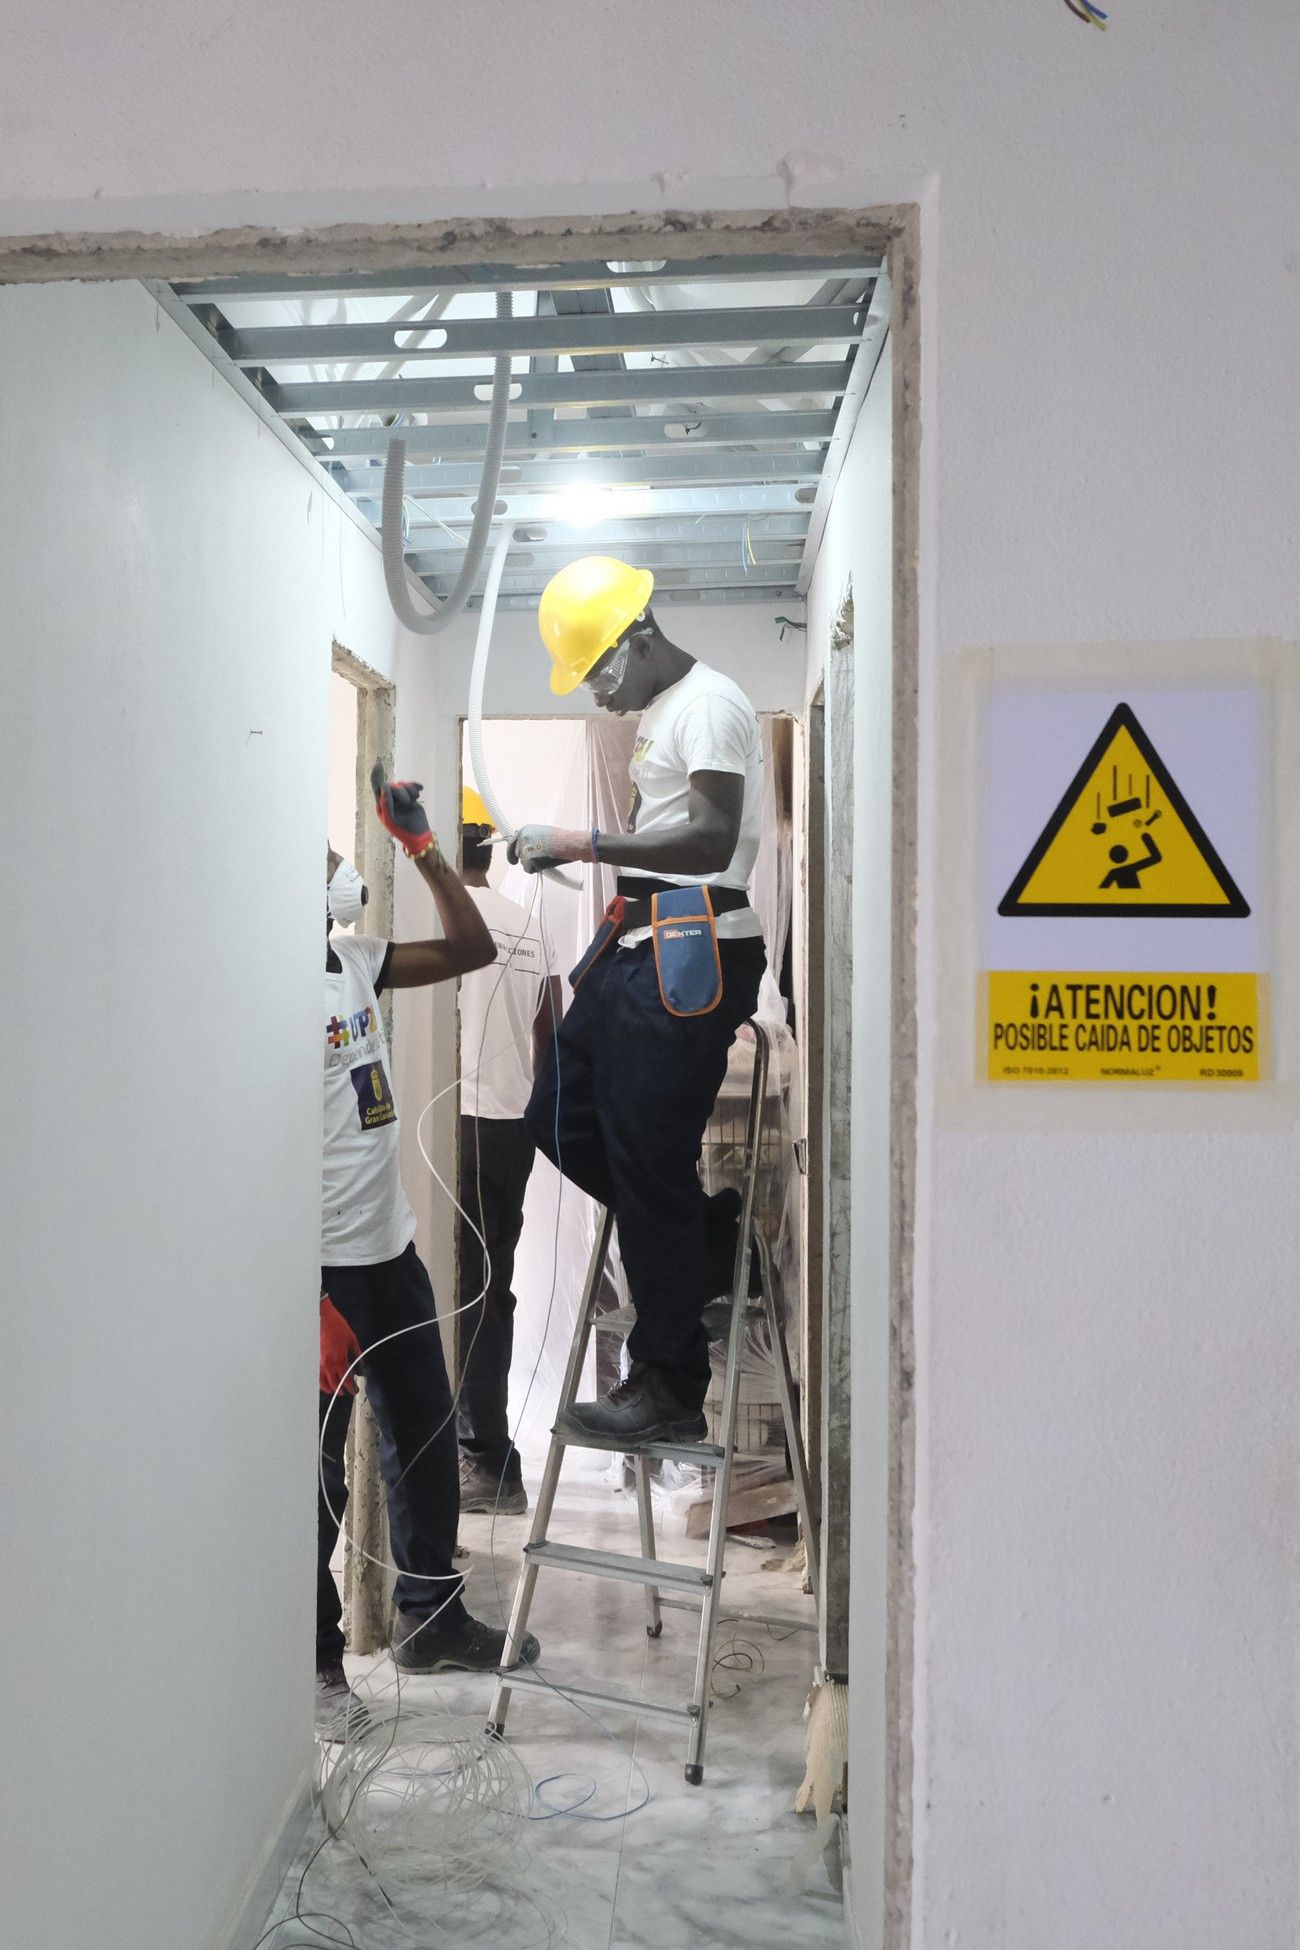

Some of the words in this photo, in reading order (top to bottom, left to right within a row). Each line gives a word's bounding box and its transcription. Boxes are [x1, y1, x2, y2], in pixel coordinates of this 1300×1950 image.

[664, 930, 702, 939] DEXTER
[1030, 983, 1217, 1021] ¡ATENCION!
[994, 1023, 1069, 1052] POSIBLE
[1074, 1024, 1132, 1053] CAIDA
[1137, 1025, 1162, 1053] DE
[1167, 1025, 1254, 1054] OBJETOS
